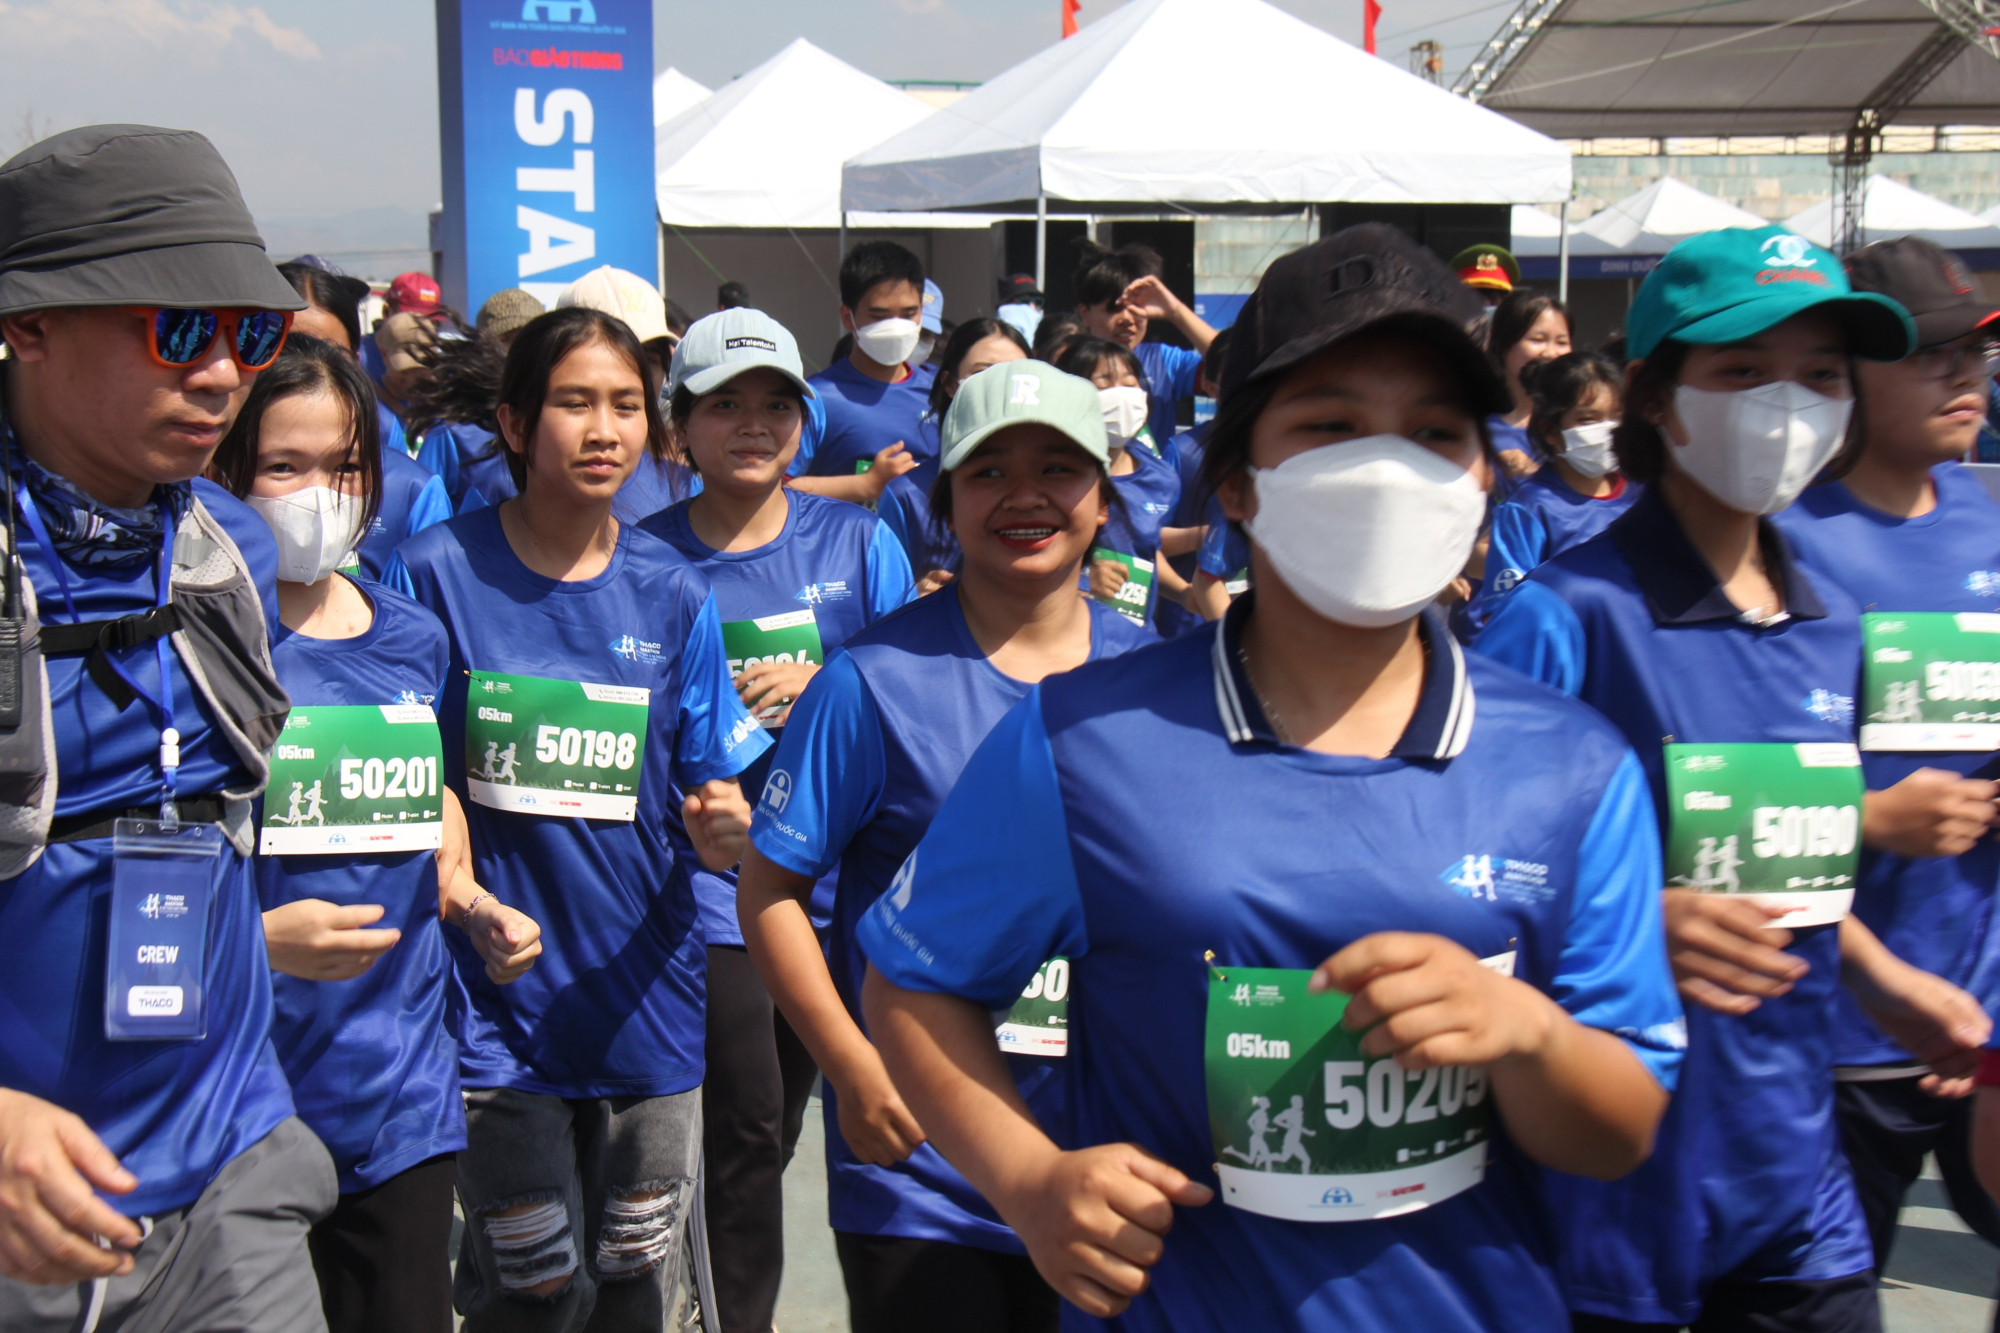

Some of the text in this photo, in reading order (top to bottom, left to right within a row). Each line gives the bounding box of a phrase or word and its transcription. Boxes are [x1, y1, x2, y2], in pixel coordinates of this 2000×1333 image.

[1009, 373, 1041, 405] R
[478, 706, 513, 724] 05km
[278, 744, 315, 760] 05km
[535, 724, 637, 771] 50198
[340, 756, 437, 800] 50201
[1752, 804, 1859, 859] 50190
[137, 944, 179, 964] CREW
[139, 997, 173, 1008] THACO
[1226, 1032, 1290, 1059] 05km
